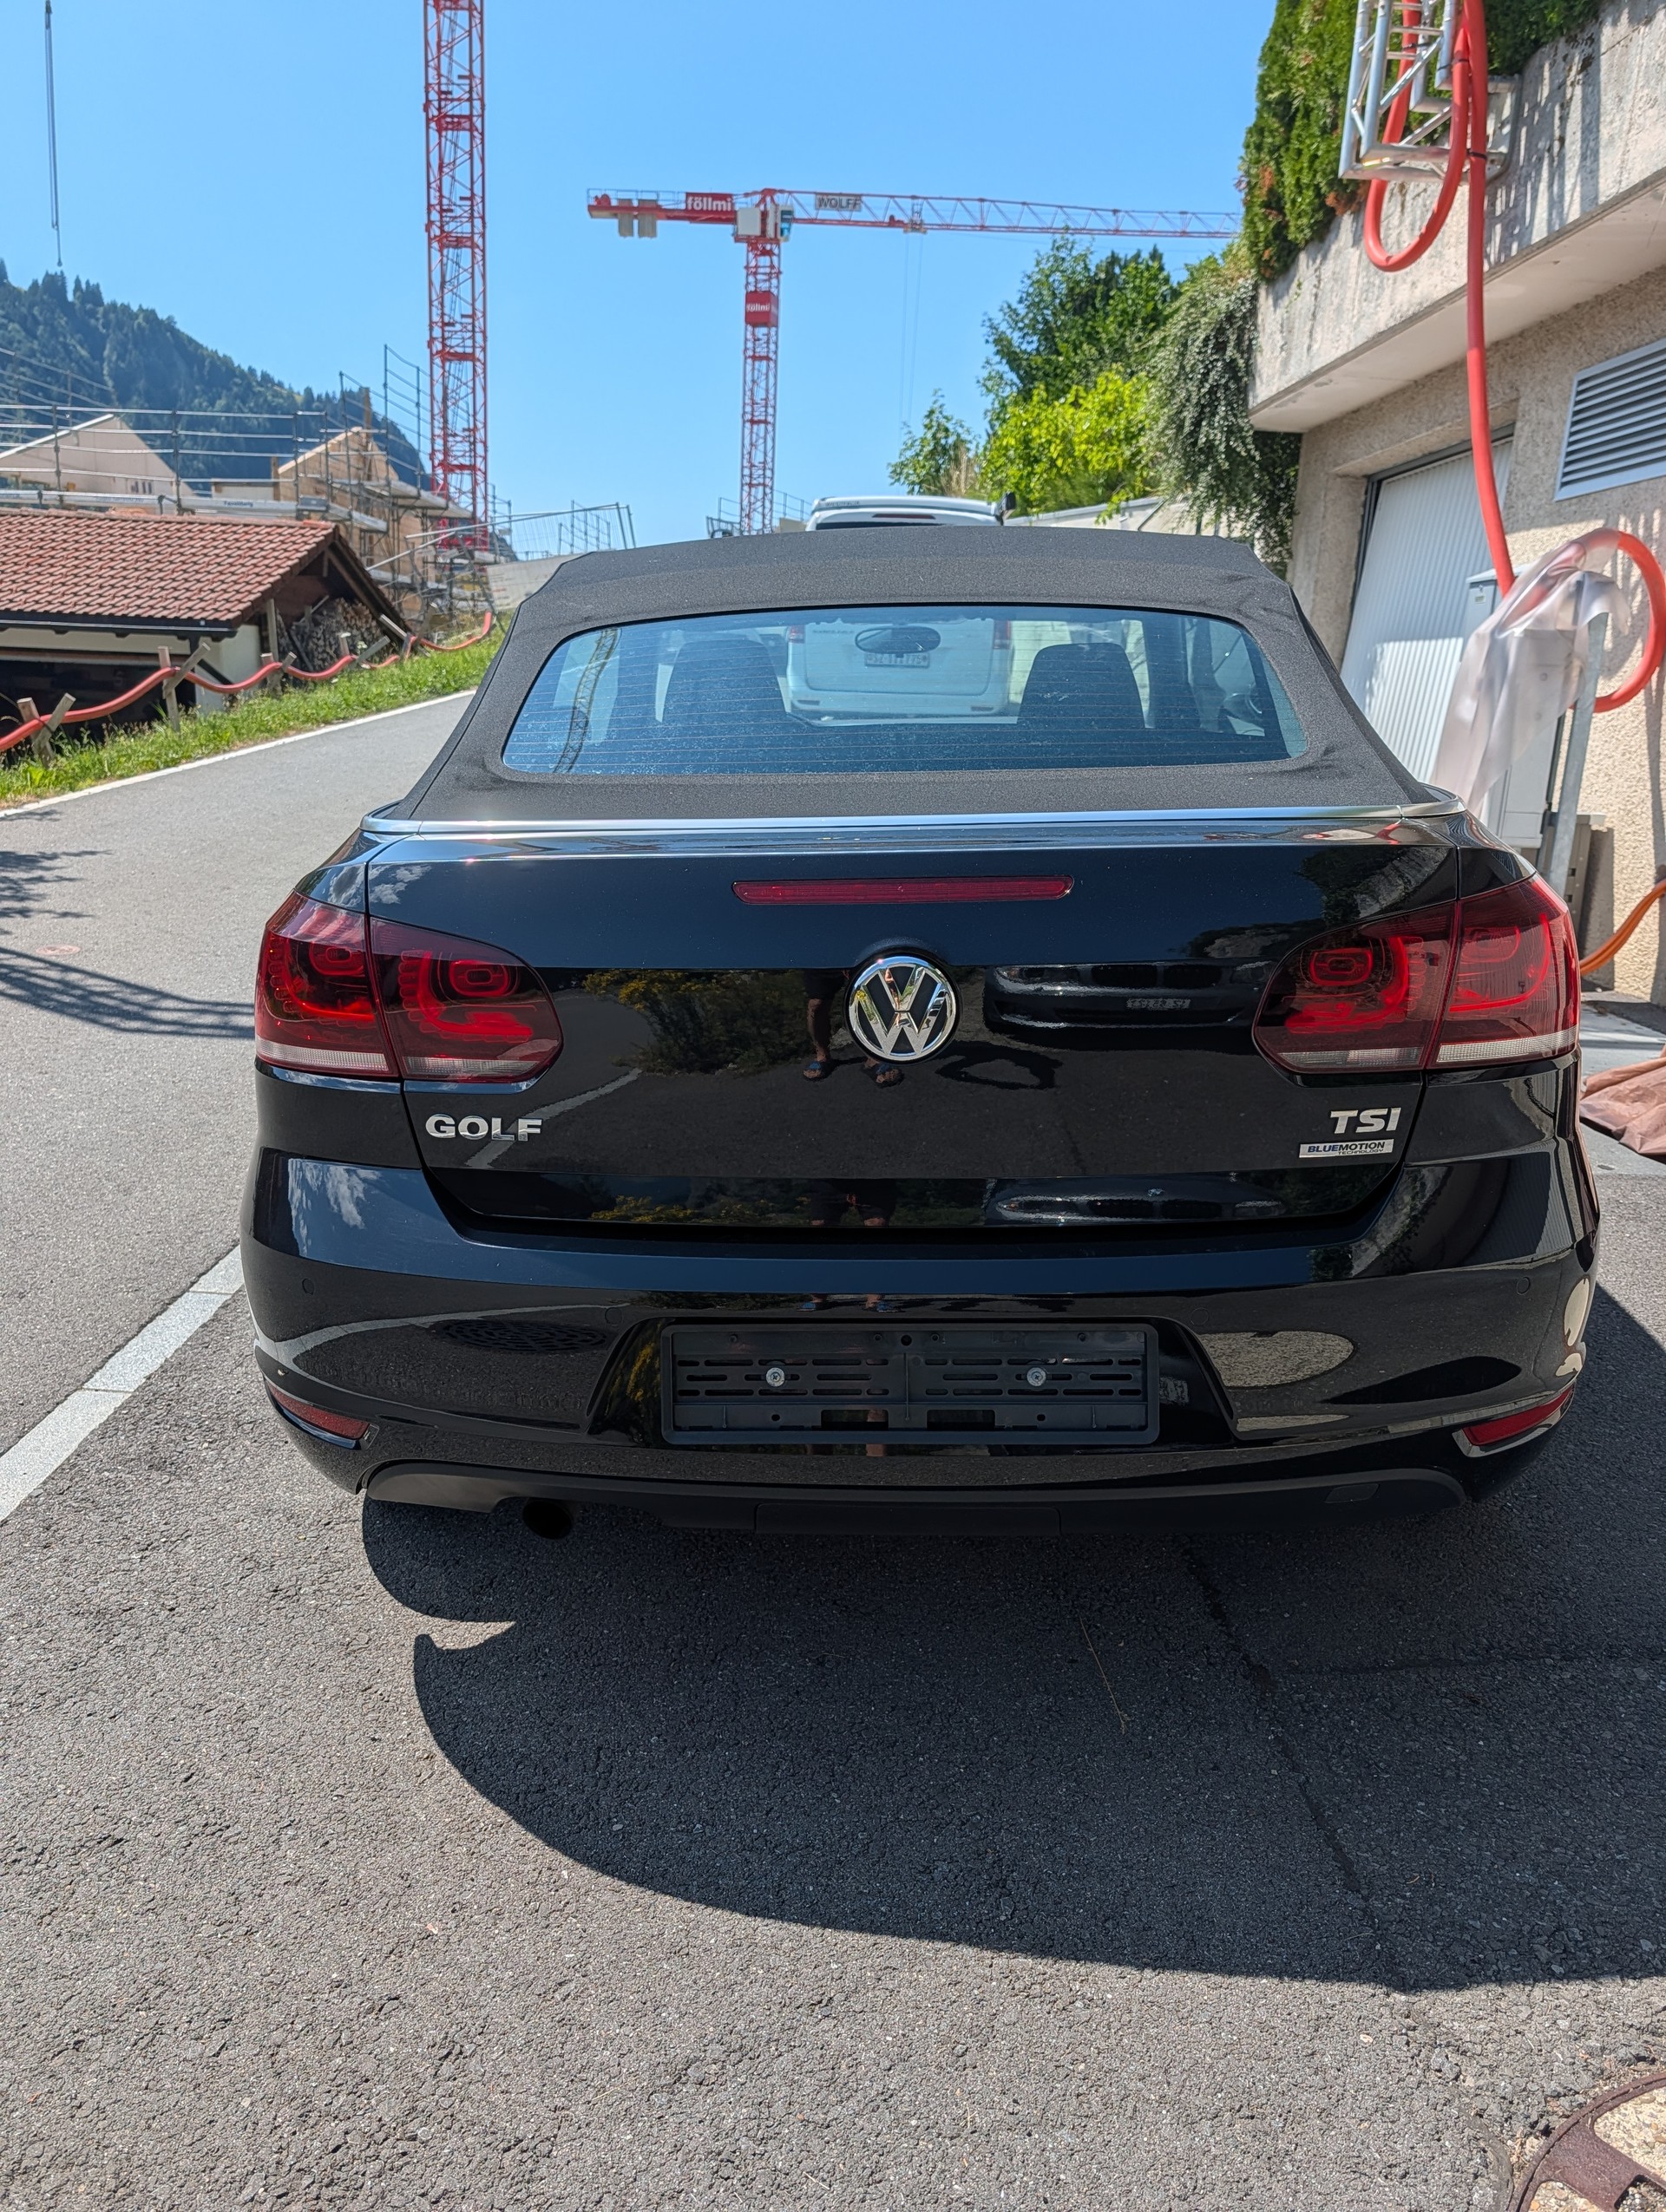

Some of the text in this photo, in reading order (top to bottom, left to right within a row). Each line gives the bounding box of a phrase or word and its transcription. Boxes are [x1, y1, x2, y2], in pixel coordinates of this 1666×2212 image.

[686, 196, 732, 212] föllmi
[817, 196, 862, 209] WOLFF
[425, 1114, 542, 1142] GOLF
[1330, 1107, 1401, 1134] TSI
[1307, 1142, 1386, 1153] BLUEMOTION
